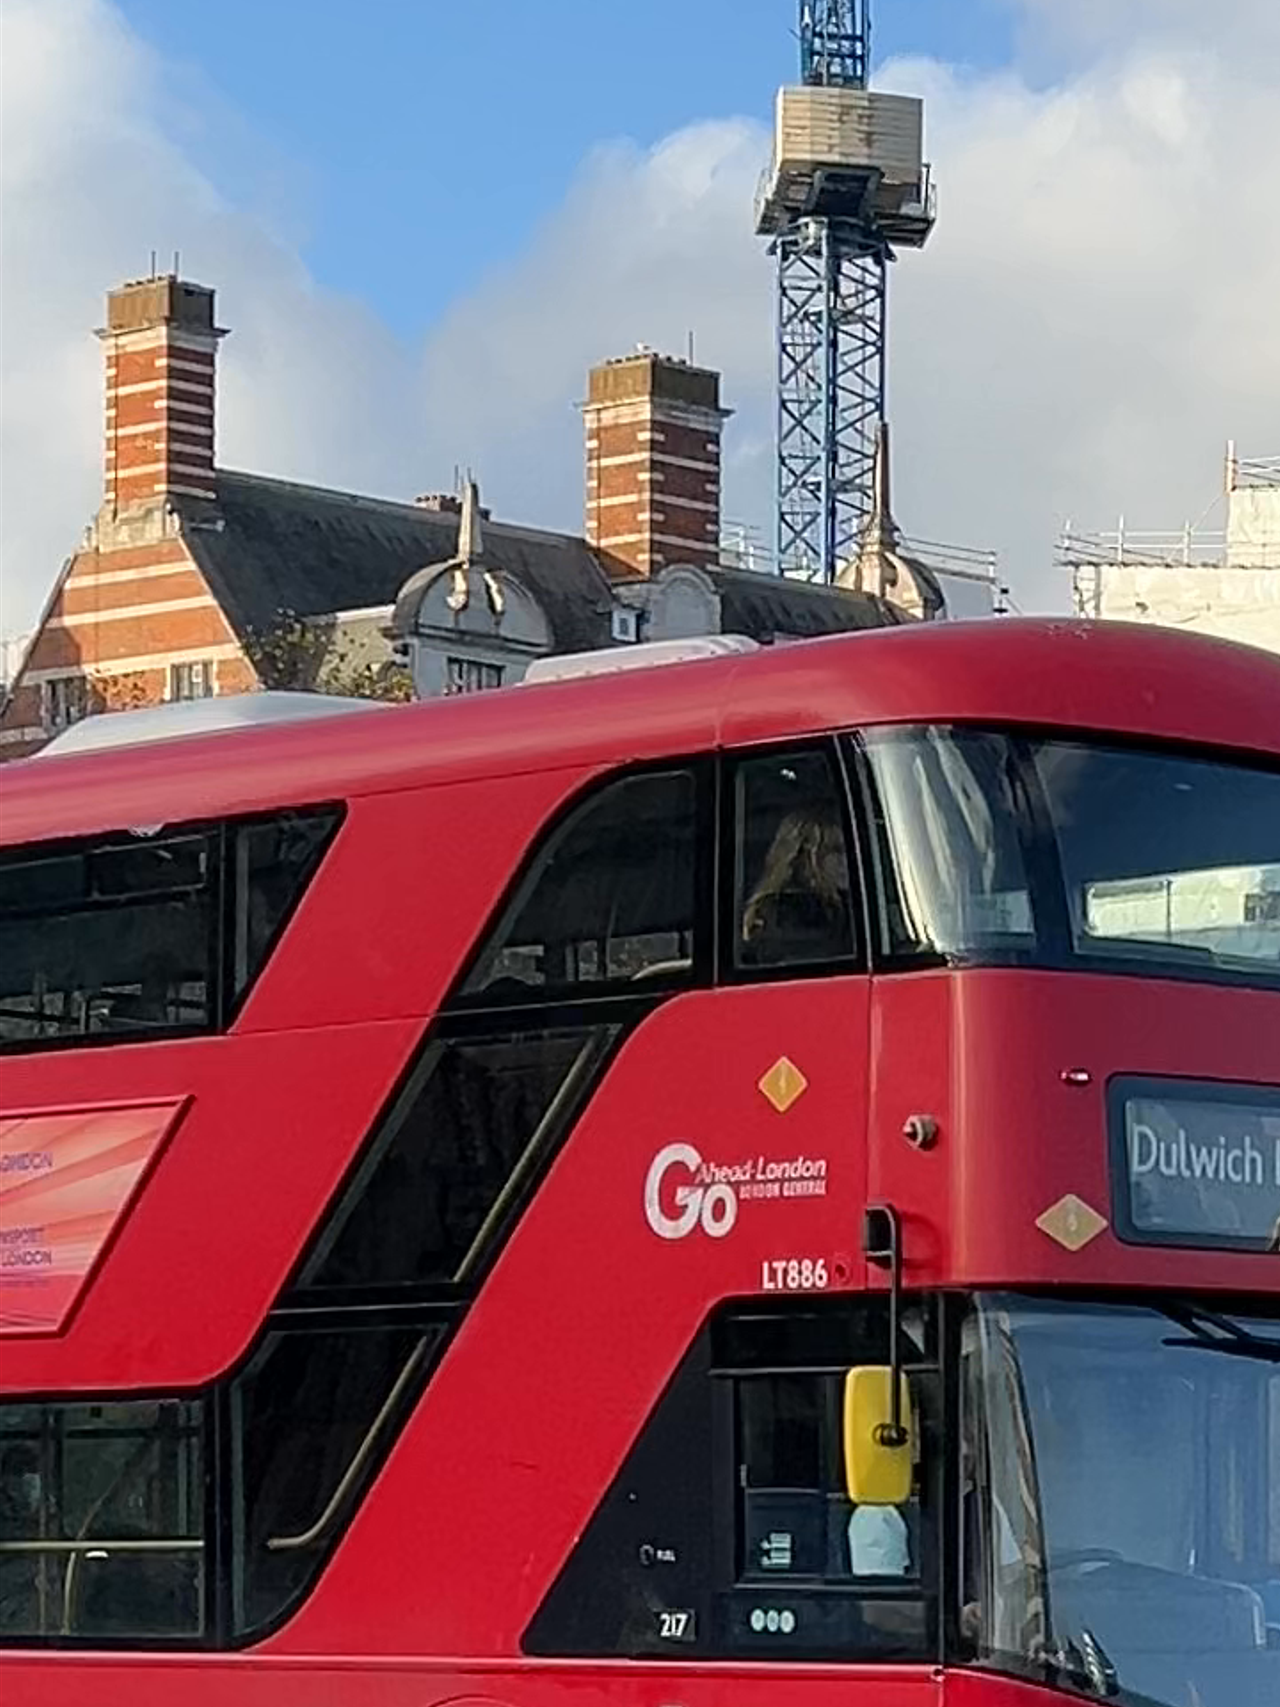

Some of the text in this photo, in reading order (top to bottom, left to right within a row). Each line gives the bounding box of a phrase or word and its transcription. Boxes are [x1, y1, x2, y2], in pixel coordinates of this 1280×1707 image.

[1131, 1123, 1264, 1188] Dulwich
[644, 1142, 738, 1240] Go
[761, 1258, 829, 1290] LT886
